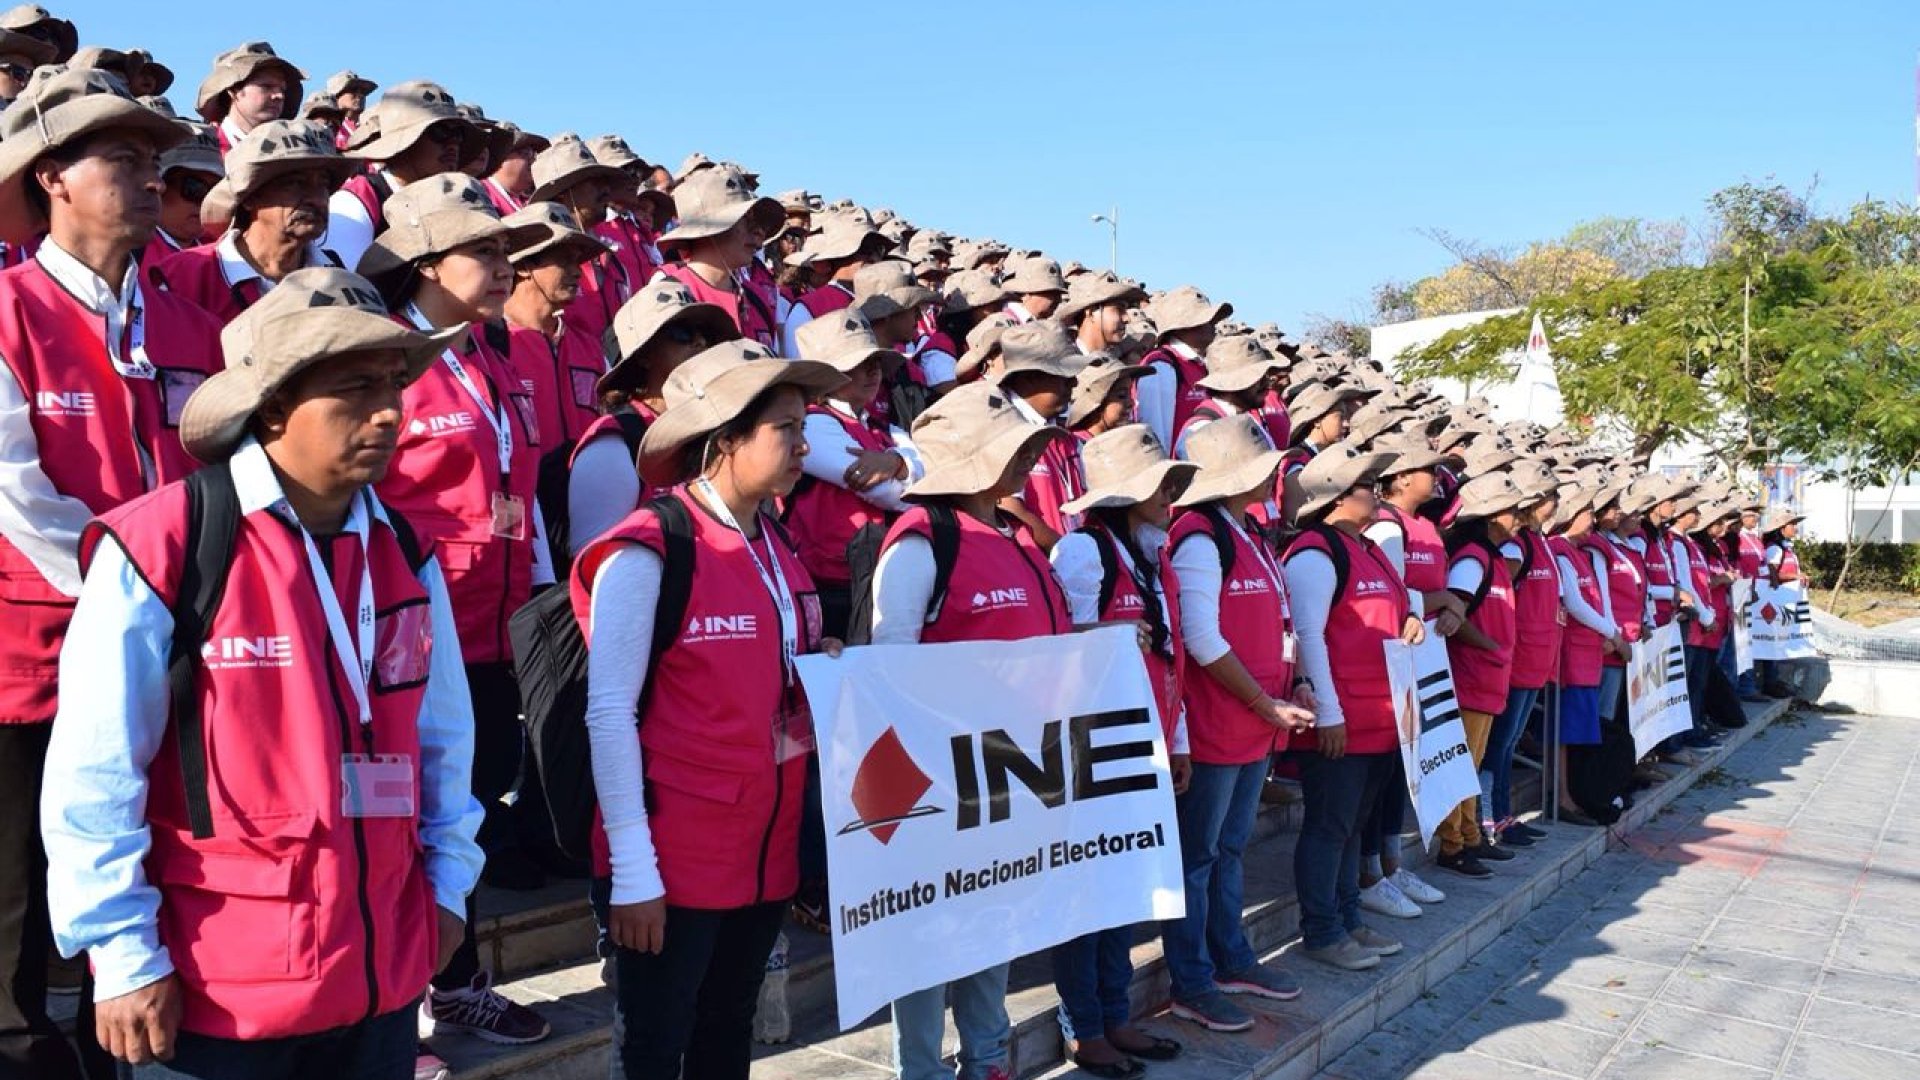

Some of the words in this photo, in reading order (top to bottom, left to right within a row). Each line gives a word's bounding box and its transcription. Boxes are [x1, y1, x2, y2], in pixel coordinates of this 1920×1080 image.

[340, 287, 384, 306] IN
[36, 392, 95, 409] INE
[428, 412, 474, 431] INE
[1244, 578, 1269, 590] INE
[990, 587, 1027, 603] INE
[704, 614, 757, 633] INE
[222, 635, 292, 659] INE
[951, 707, 1158, 831] INE
[840, 880, 936, 936] Instituto
[944, 847, 1043, 899] Nacional
[1049, 822, 1165, 869] Electoral
